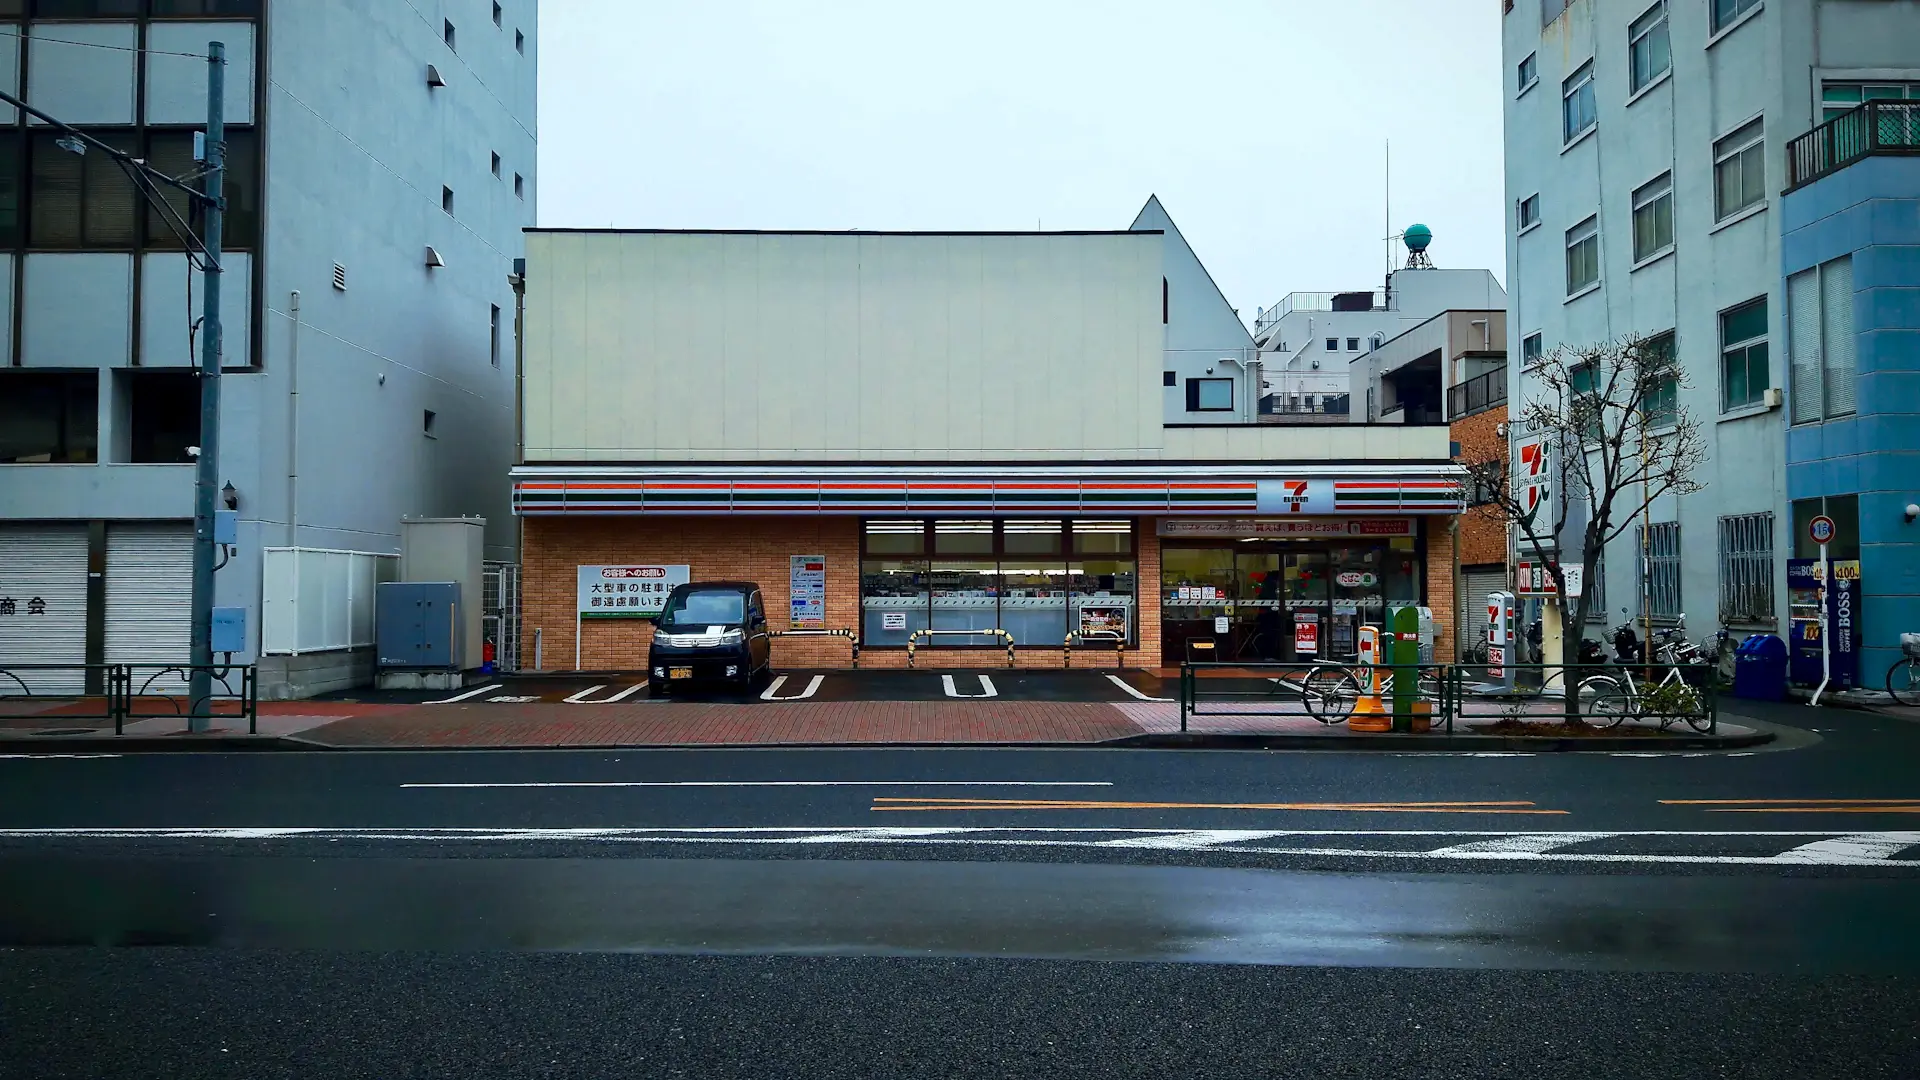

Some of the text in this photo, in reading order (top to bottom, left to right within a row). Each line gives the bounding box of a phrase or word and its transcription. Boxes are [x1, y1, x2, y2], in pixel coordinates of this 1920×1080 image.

[603, 568, 665, 578] お客様へのお願い
[1801, 565, 1815, 577] BOS
[591, 582, 676, 593] 大型車の駐車は
[1837, 591, 1851, 628] BOSS
